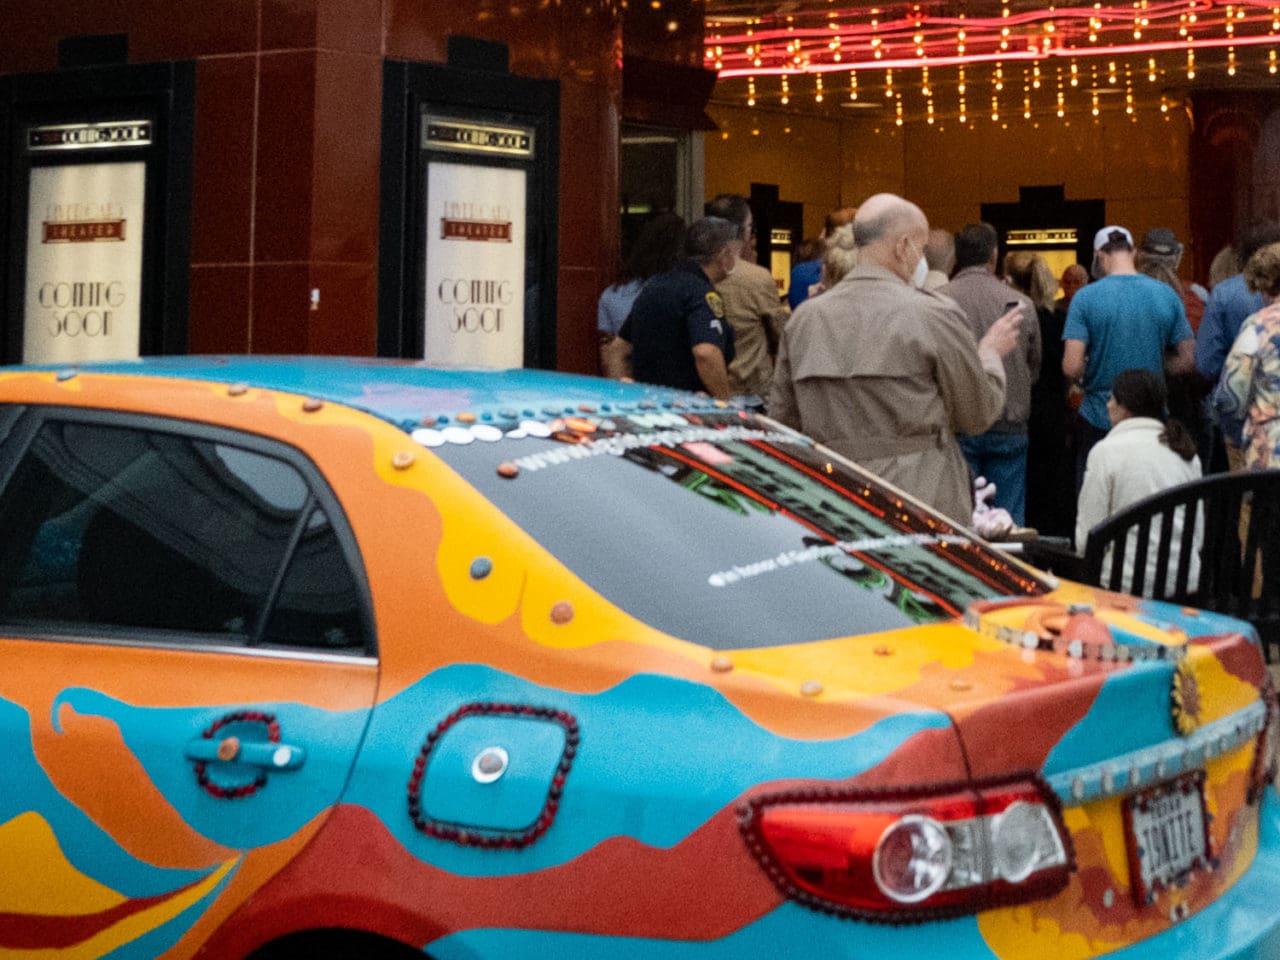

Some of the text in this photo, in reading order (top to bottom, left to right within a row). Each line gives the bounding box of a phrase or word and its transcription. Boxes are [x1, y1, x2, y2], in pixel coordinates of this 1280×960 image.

[38, 281, 126, 309] COMING
[437, 279, 514, 306] COMING
[47, 309, 114, 338] SOON
[448, 306, 505, 334] SOON
